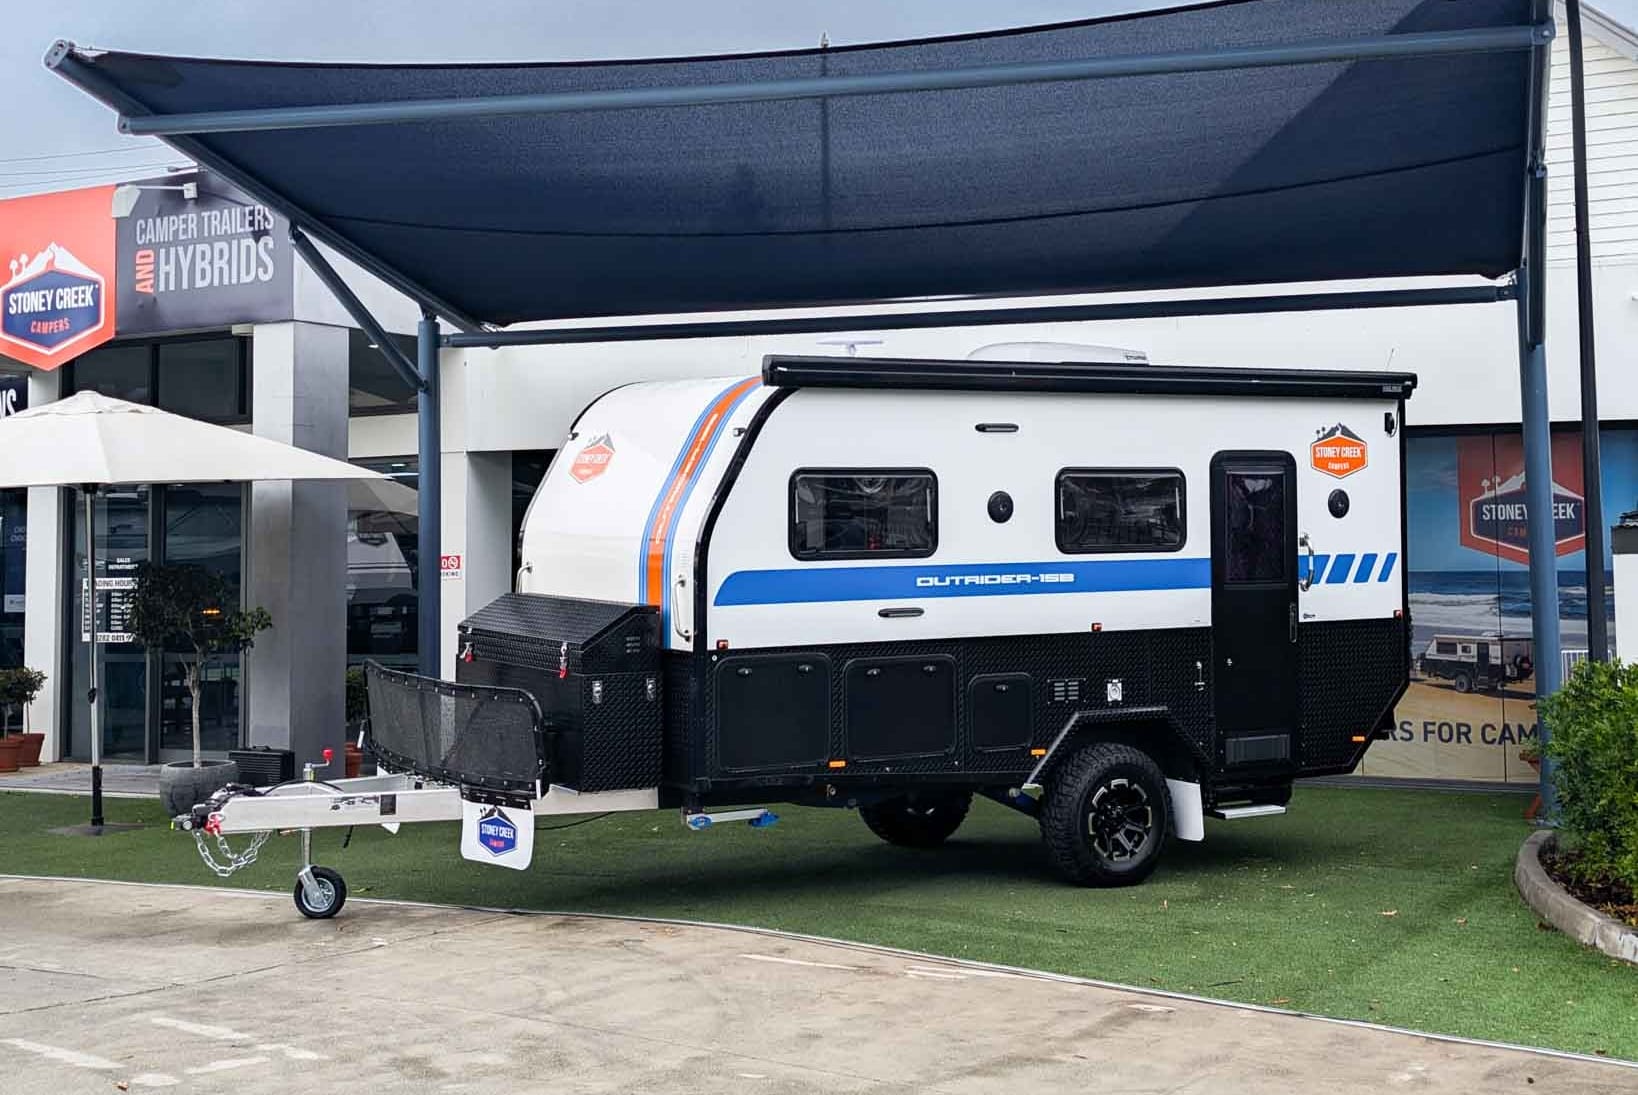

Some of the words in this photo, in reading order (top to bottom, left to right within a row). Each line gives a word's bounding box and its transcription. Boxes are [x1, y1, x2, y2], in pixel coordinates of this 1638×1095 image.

[136, 213, 197, 245] CAMPER
[201, 204, 274, 237] TRAILERS
[136, 249, 154, 294] AND
[159, 236, 274, 292] HYBRIDS
[8, 289, 53, 315] STONEY
[56, 284, 94, 310] CREEK
[30, 318, 70, 334] CAMPERS
[1315, 446, 1340, 458] STONEY
[1341, 446, 1361, 458] CREEK
[1552, 503, 1575, 519] EEK
[1423, 721, 1472, 744] FOR
